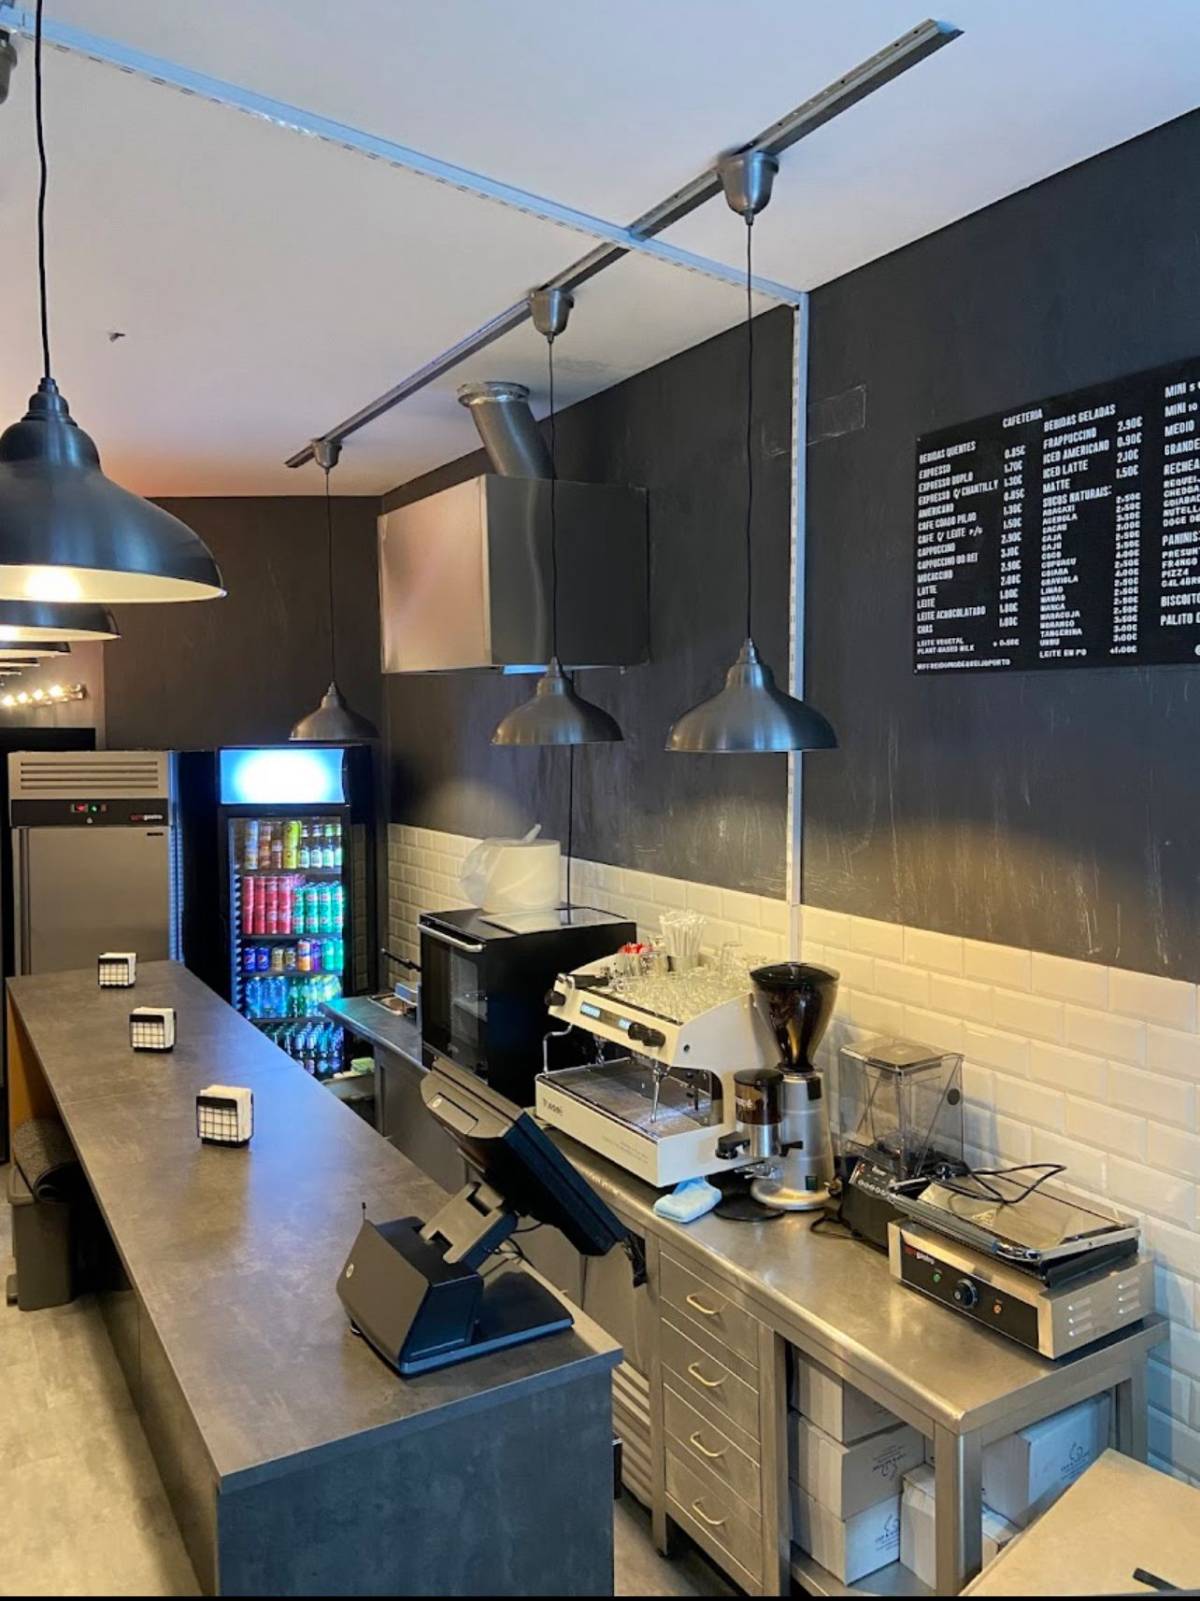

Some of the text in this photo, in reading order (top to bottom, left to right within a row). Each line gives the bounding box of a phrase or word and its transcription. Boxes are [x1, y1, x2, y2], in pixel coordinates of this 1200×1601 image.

[1165, 382, 1186, 398] MINI
[1165, 402, 1186, 417] MINI
[1003, 408, 1043, 428] CAFETERIA
[1044, 404, 1116, 432] BEBIDAS GELADAS
[1043, 427, 1097, 450] FRAPPUCCINO
[919, 441, 976, 464] BEBIDAS QUENTES
[1043, 439, 1109, 464] ICED AMERICANO
[919, 464, 951, 479] EXPRESSO
[1043, 459, 1088, 479] ICED LATTE
[918, 472, 973, 493] EXPRESSO DUPLO
[1043, 478, 1070, 494] MATTE
[918, 490, 950, 506] EXPRESSO
[1043, 494, 1068, 508] SUCOS
[918, 503, 954, 519] AMERICANO
[946, 527, 966, 539] LEITE
[917, 542, 955, 557] CAPPUCCINO
[917, 585, 937, 596] LATTE
[917, 597, 935, 609] LEITE
[917, 611, 935, 622] LEITE
[1160, 613, 1193, 626] PALITO
